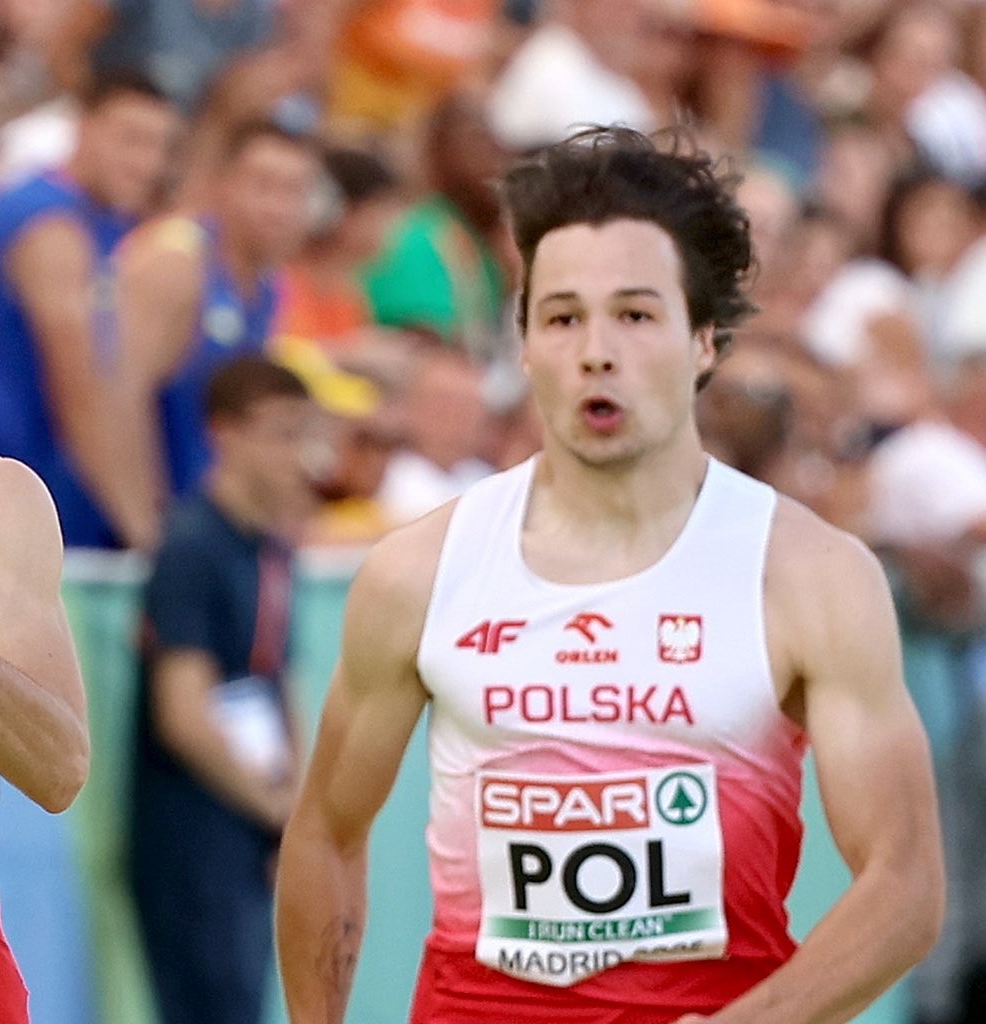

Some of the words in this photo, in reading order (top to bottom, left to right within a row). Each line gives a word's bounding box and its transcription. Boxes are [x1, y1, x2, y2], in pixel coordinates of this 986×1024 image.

[456, 619, 527, 654] 4F
[555, 650, 619, 663] ORLEN
[483, 685, 695, 725] POLSKA
[483, 783, 646, 827] SPAR
[508, 839, 691, 914] POL
[538, 921, 585, 940] RUN
[497, 946, 624, 976] MADRID
